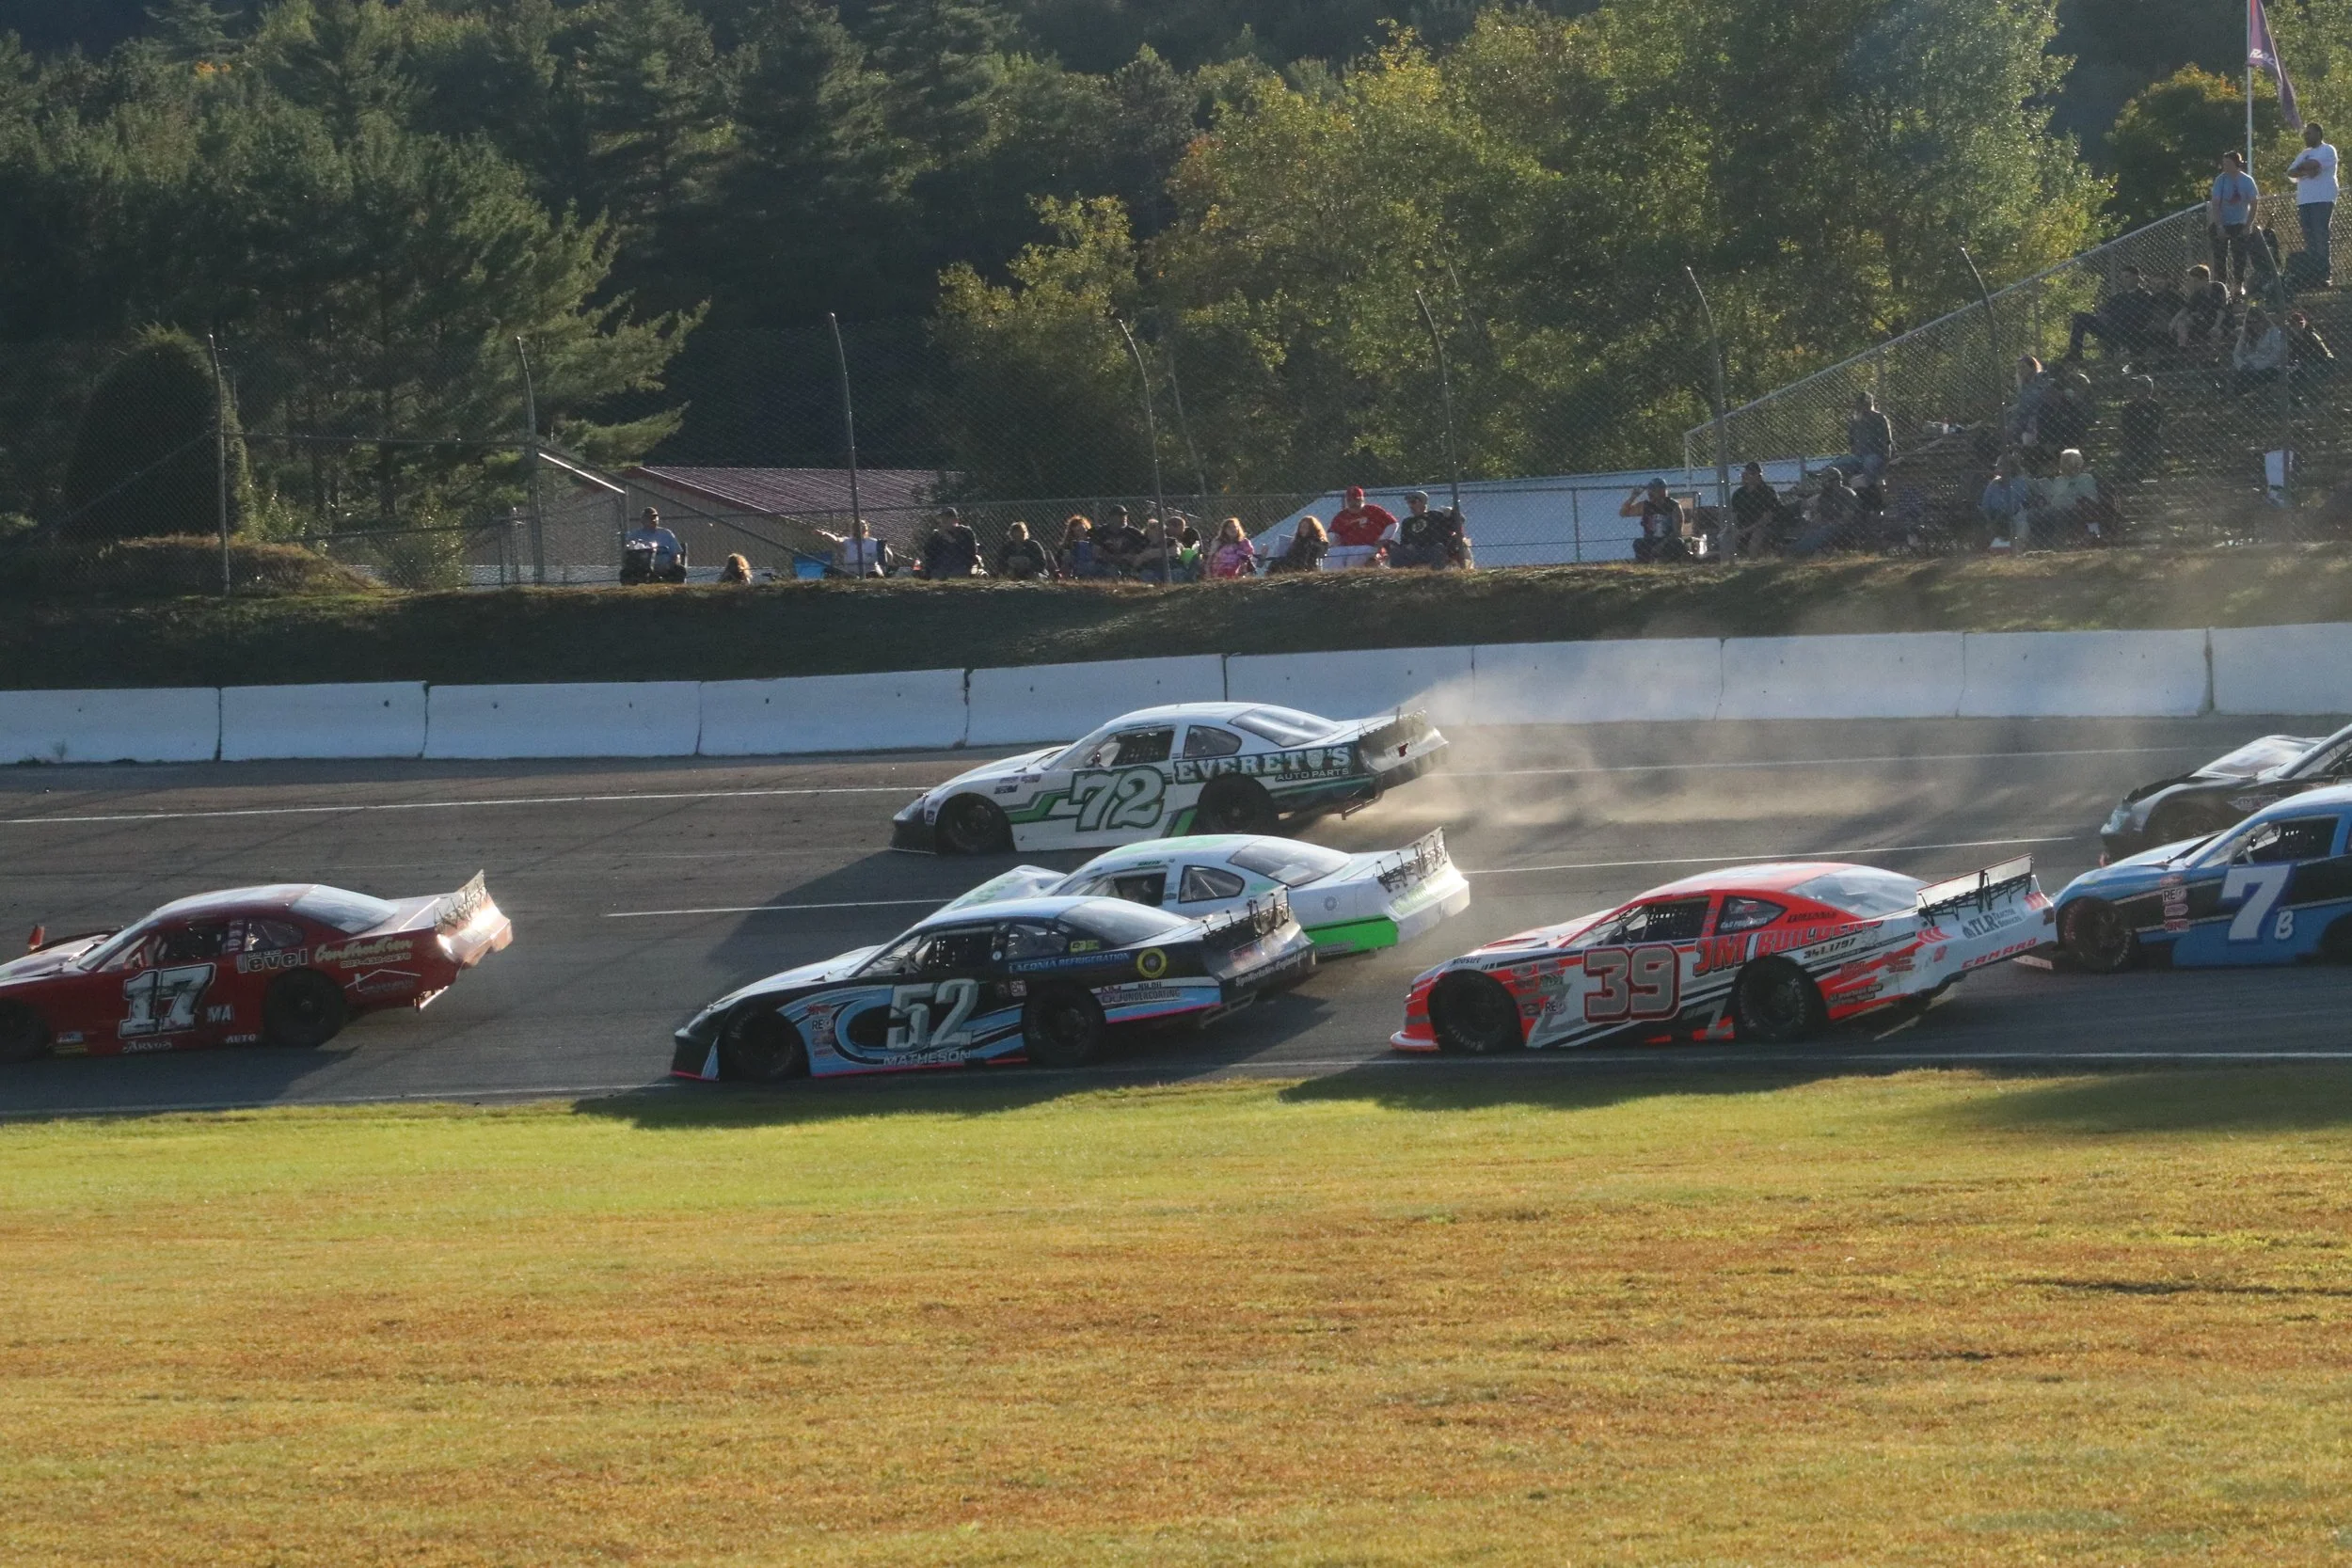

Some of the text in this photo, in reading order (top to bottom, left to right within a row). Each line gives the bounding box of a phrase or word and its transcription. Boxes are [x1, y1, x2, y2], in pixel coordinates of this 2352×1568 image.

[1069, 765, 1166, 832] 72
[1277, 768, 1349, 781] AUTO PARTS
[2221, 863, 2293, 941] 7
[1009, 959, 1057, 974] LACONIA
[1058, 952, 1129, 968] REFRIGERATION
[1583, 943, 1681, 1023] 39
[1962, 938, 2037, 970] CAMARO
[119, 962, 216, 1039] 17
[886, 977, 979, 1051] 52
[882, 1049, 971, 1066] MATHESON
